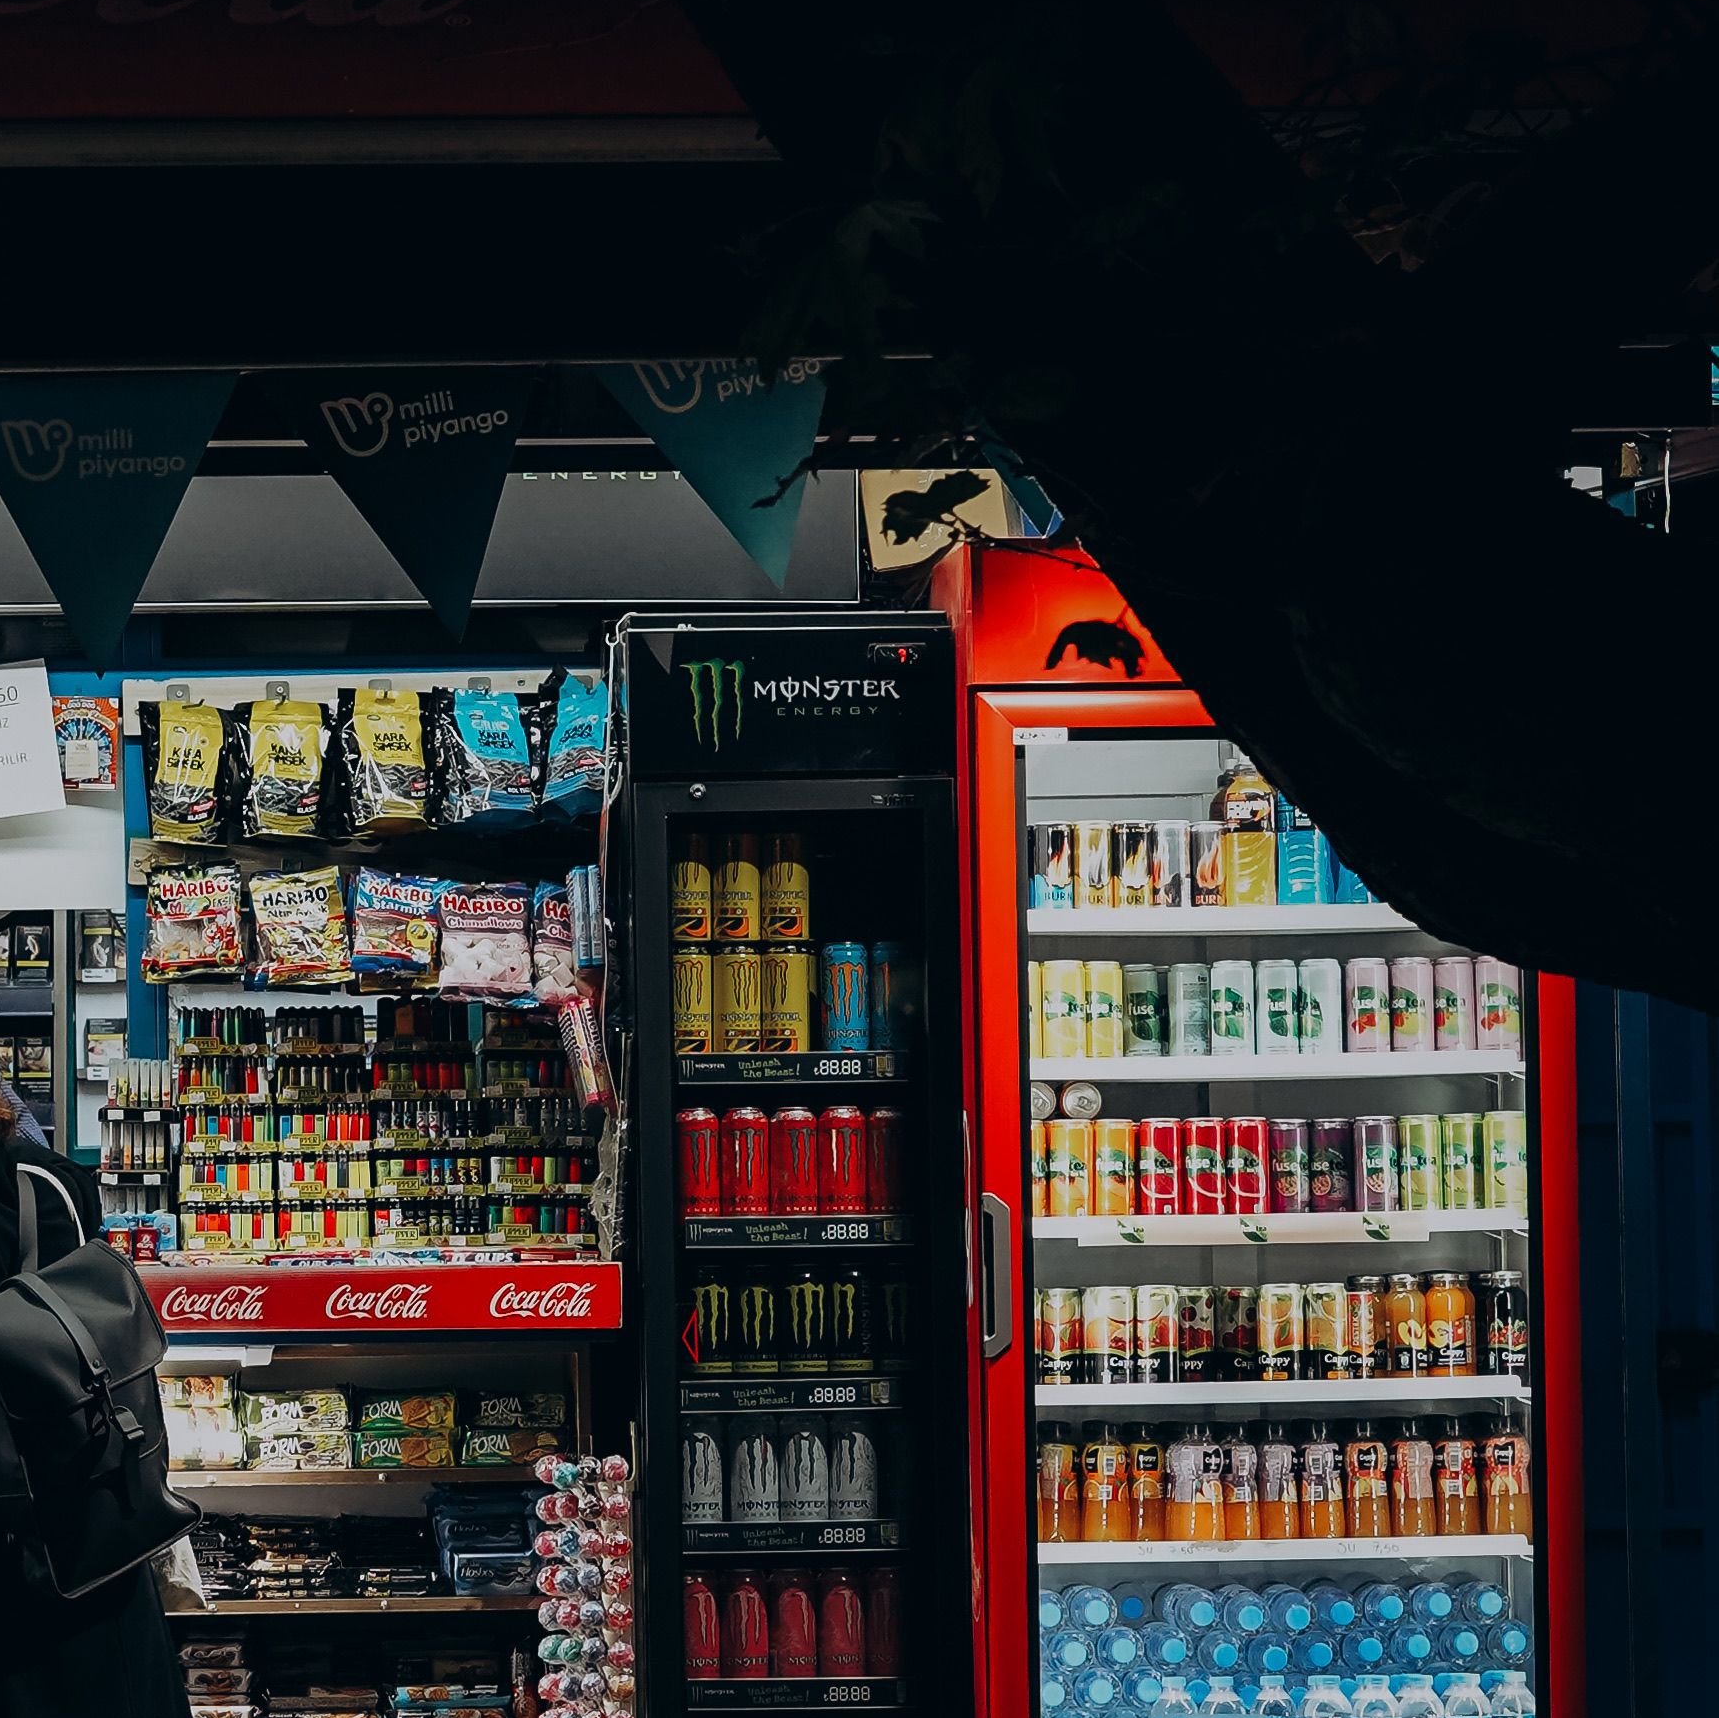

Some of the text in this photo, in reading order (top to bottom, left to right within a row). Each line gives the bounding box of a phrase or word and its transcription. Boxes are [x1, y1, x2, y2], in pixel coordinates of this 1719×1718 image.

[400, 390, 453, 422] milli
[403, 407, 509, 449] piyango
[78, 427, 134, 452] milli
[78, 451, 187, 480] piyango
[752, 674, 901, 700] MONSTER
[776, 706, 881, 716] ENERGY
[161, 880, 229, 897] HARIBO
[262, 886, 327, 907] HARIBO
[368, 883, 434, 903] HARIBO
[443, 894, 524, 914] HARIBO
[447, 917, 522, 930] Chamallows
[161, 1282, 596, 1321] Coca-Cola Coca-Cola Coca-Cola
[361, 1399, 403, 1419] FORM
[480, 1397, 521, 1415] FORM
[360, 1438, 402, 1458] FORM
[469, 1433, 510, 1453] FORM
